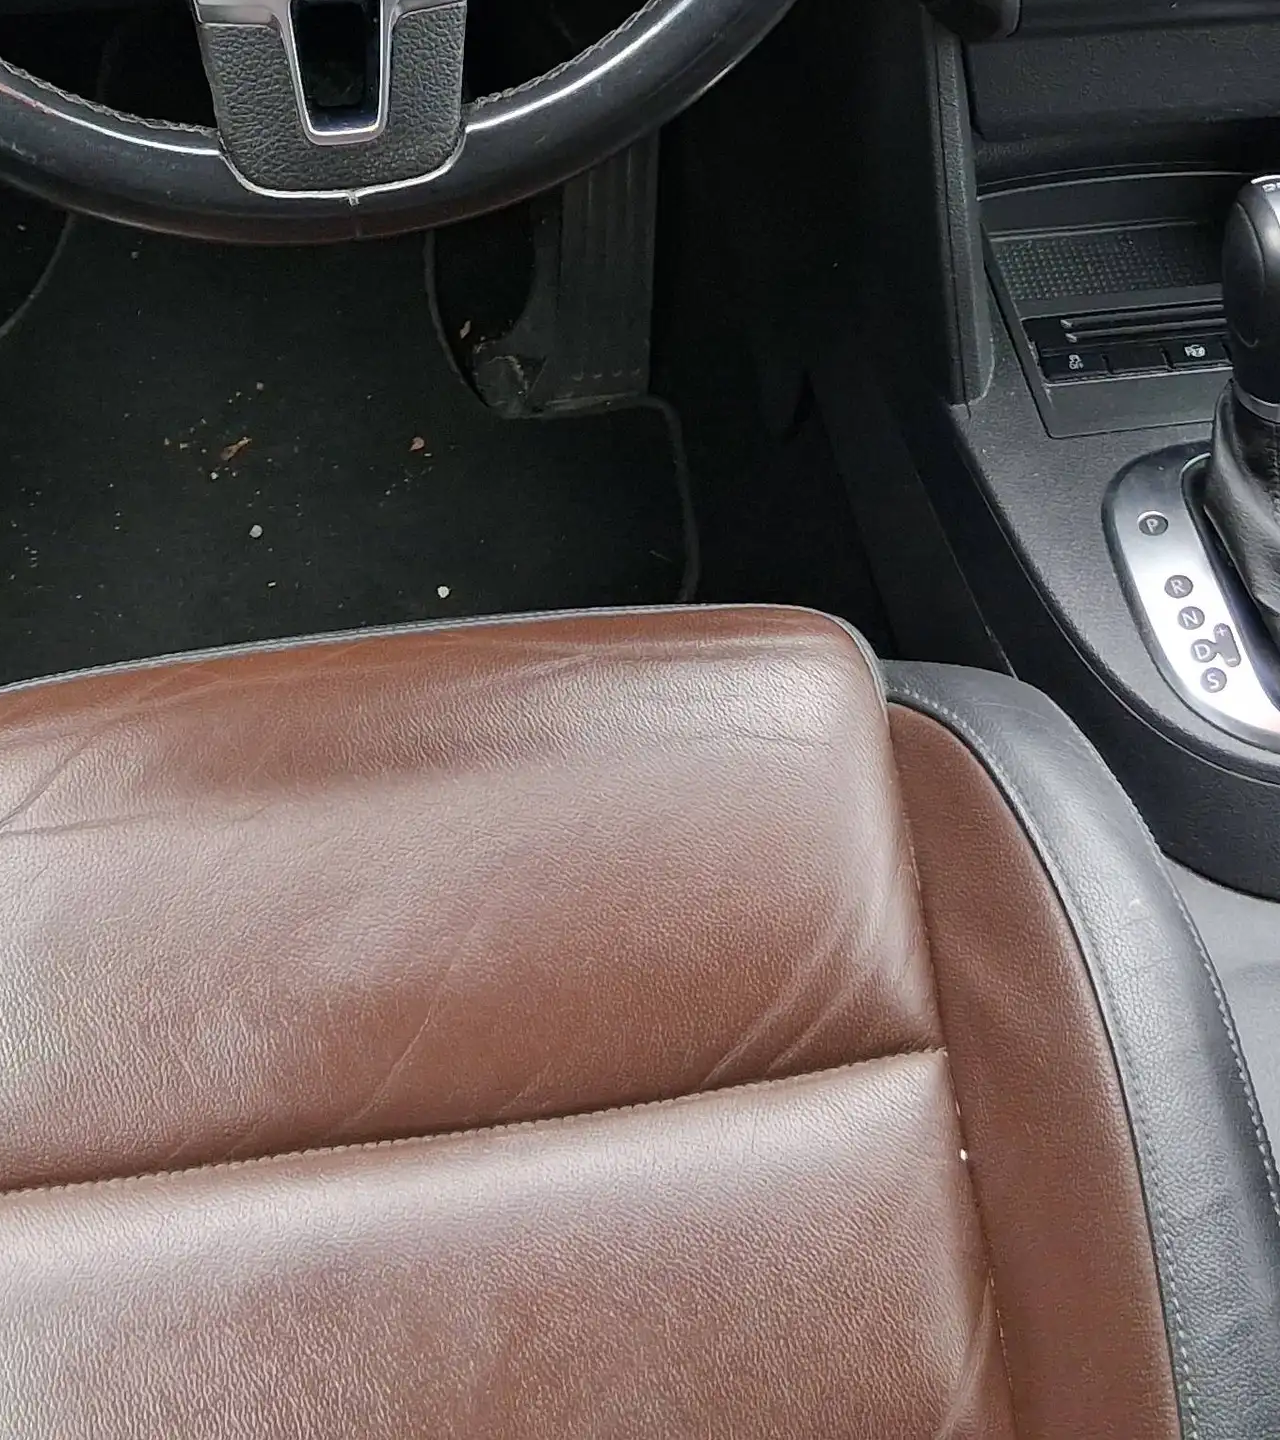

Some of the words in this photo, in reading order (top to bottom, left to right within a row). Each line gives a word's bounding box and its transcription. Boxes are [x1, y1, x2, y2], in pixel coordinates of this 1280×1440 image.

[1146, 519, 1158, 533] P
[1170, 580, 1185, 594] R
[1181, 611, 1198, 627] N
[1195, 644, 1211, 660] D
[1207, 673, 1220, 689] S
